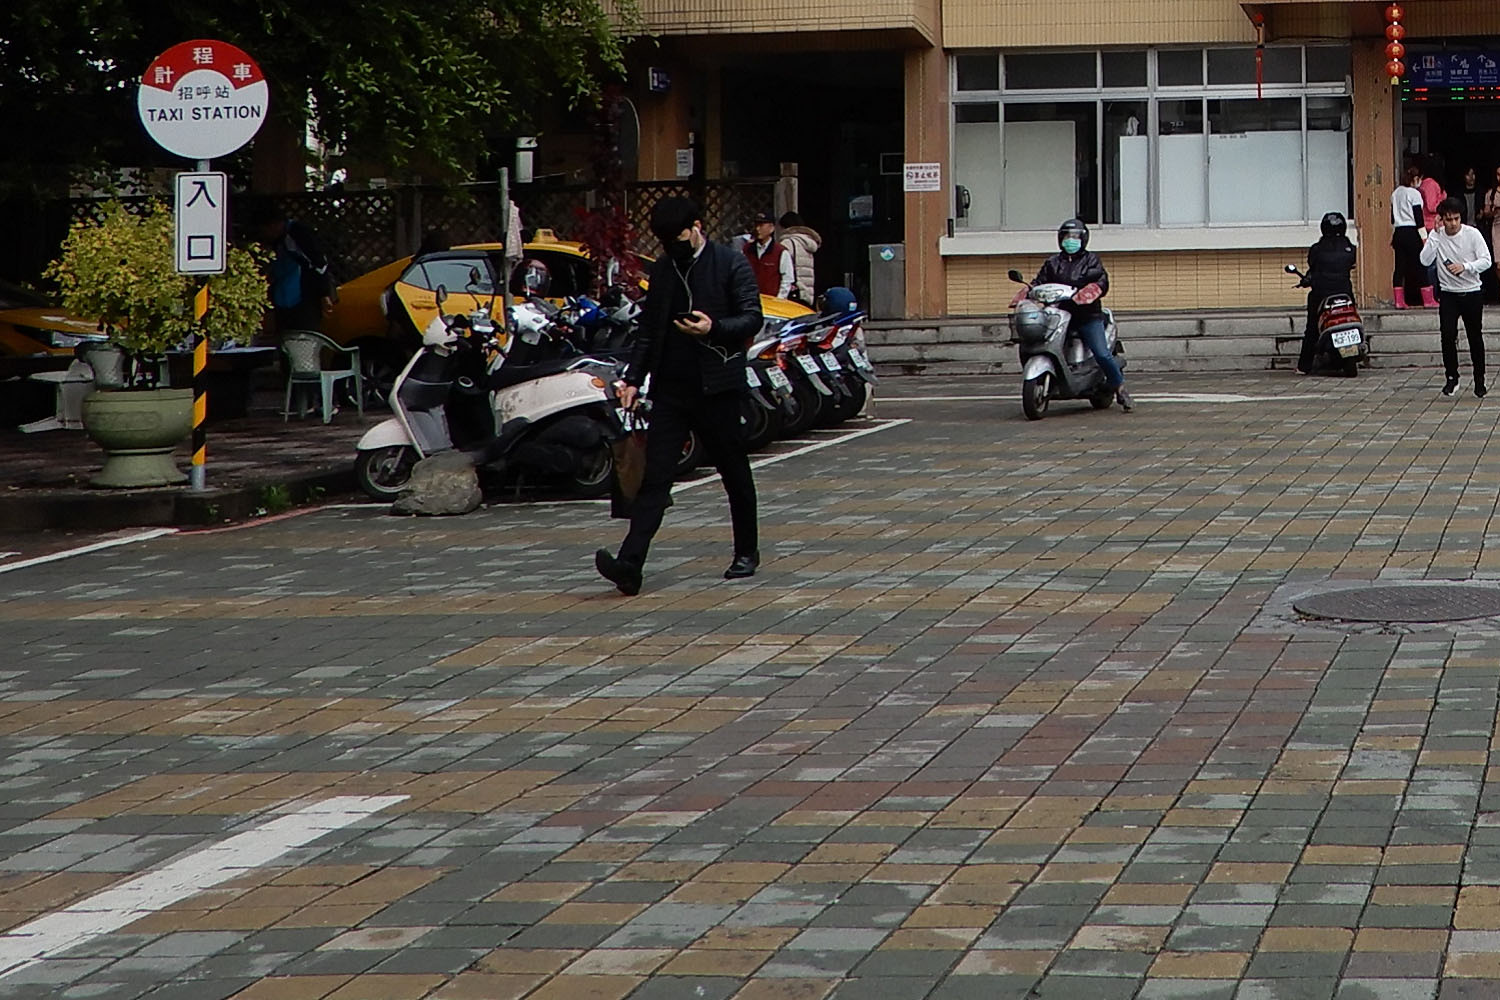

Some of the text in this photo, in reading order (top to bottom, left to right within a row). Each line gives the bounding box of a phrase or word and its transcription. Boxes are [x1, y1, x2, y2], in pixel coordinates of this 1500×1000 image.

[155, 47, 252, 83] 計程車
[178, 86, 230, 100] 招呼站
[148, 105, 261, 121] TAXI STATION
[187, 180, 217, 261] 入口
